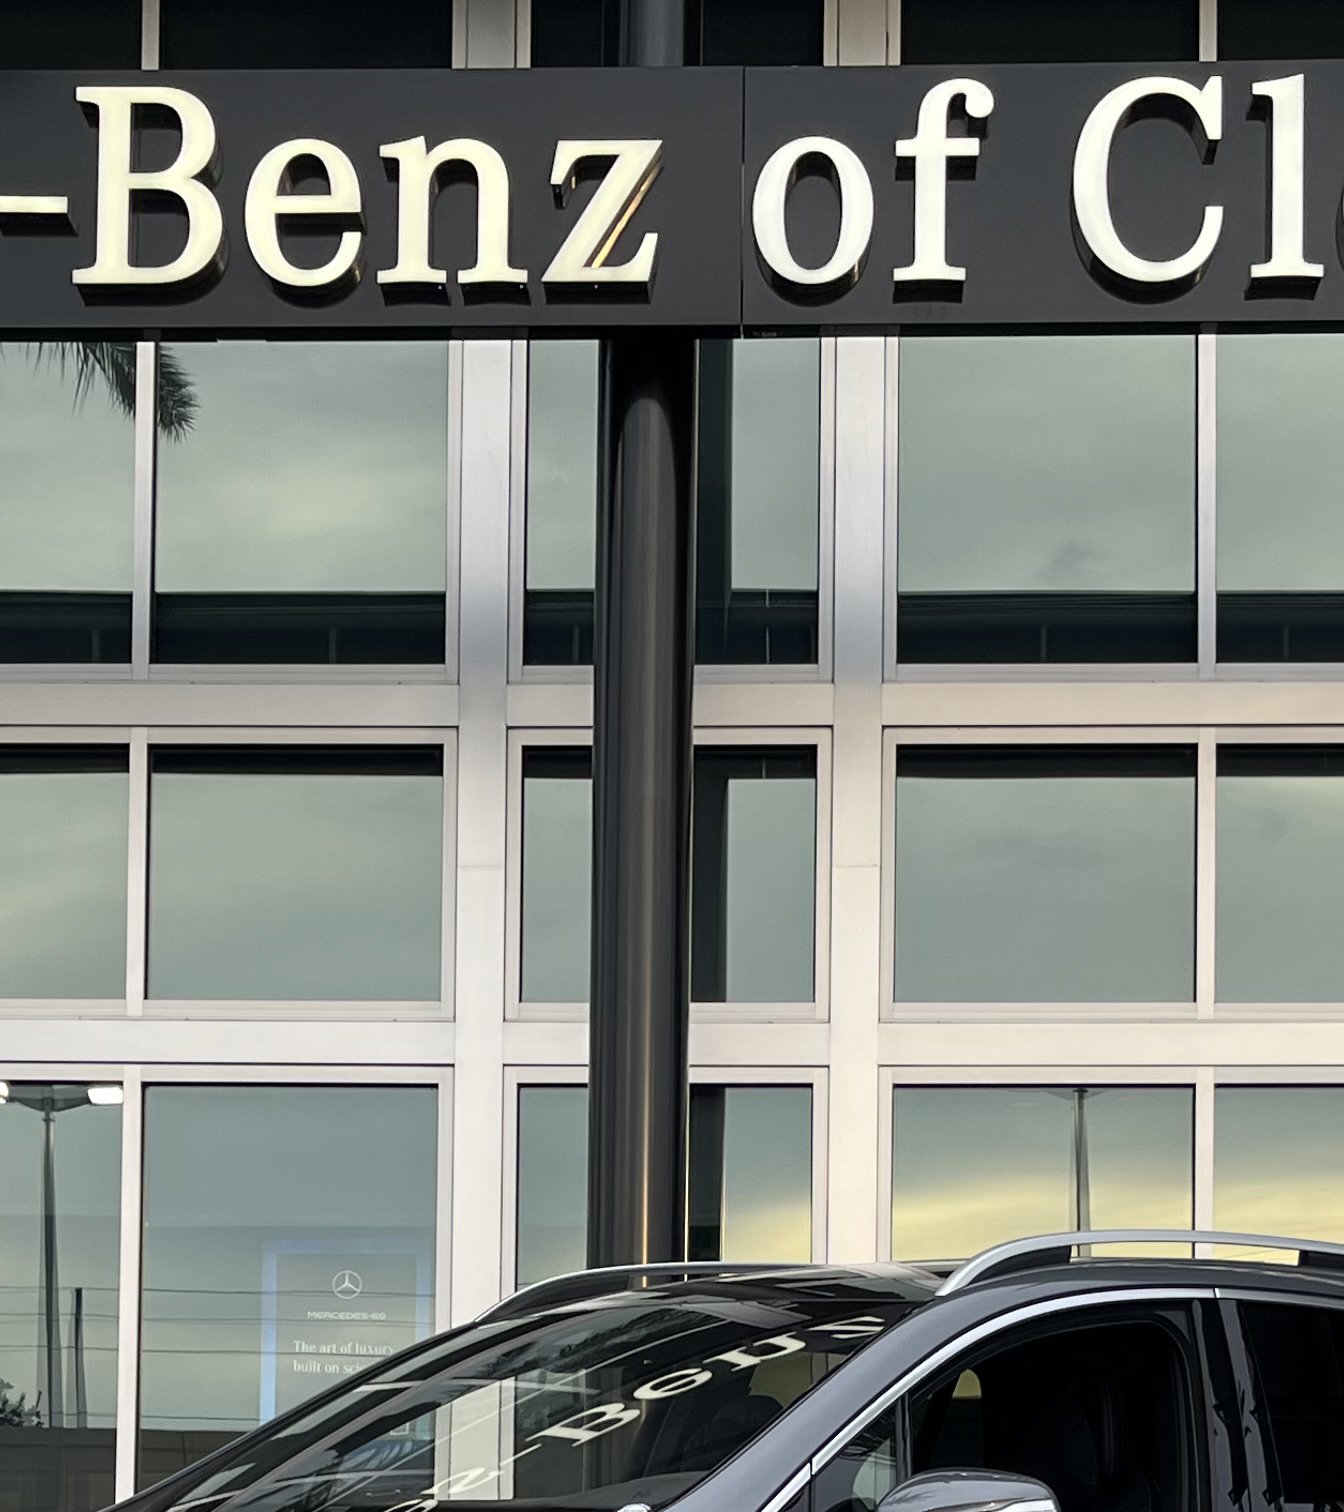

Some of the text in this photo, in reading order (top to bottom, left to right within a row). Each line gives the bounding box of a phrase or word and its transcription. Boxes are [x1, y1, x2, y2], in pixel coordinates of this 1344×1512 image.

[751, 78, 995, 286] of
[293, 1340, 393, 1356] The art of luxury
[293, 1360, 321, 1373] built
[324, 1363, 340, 1373] on
